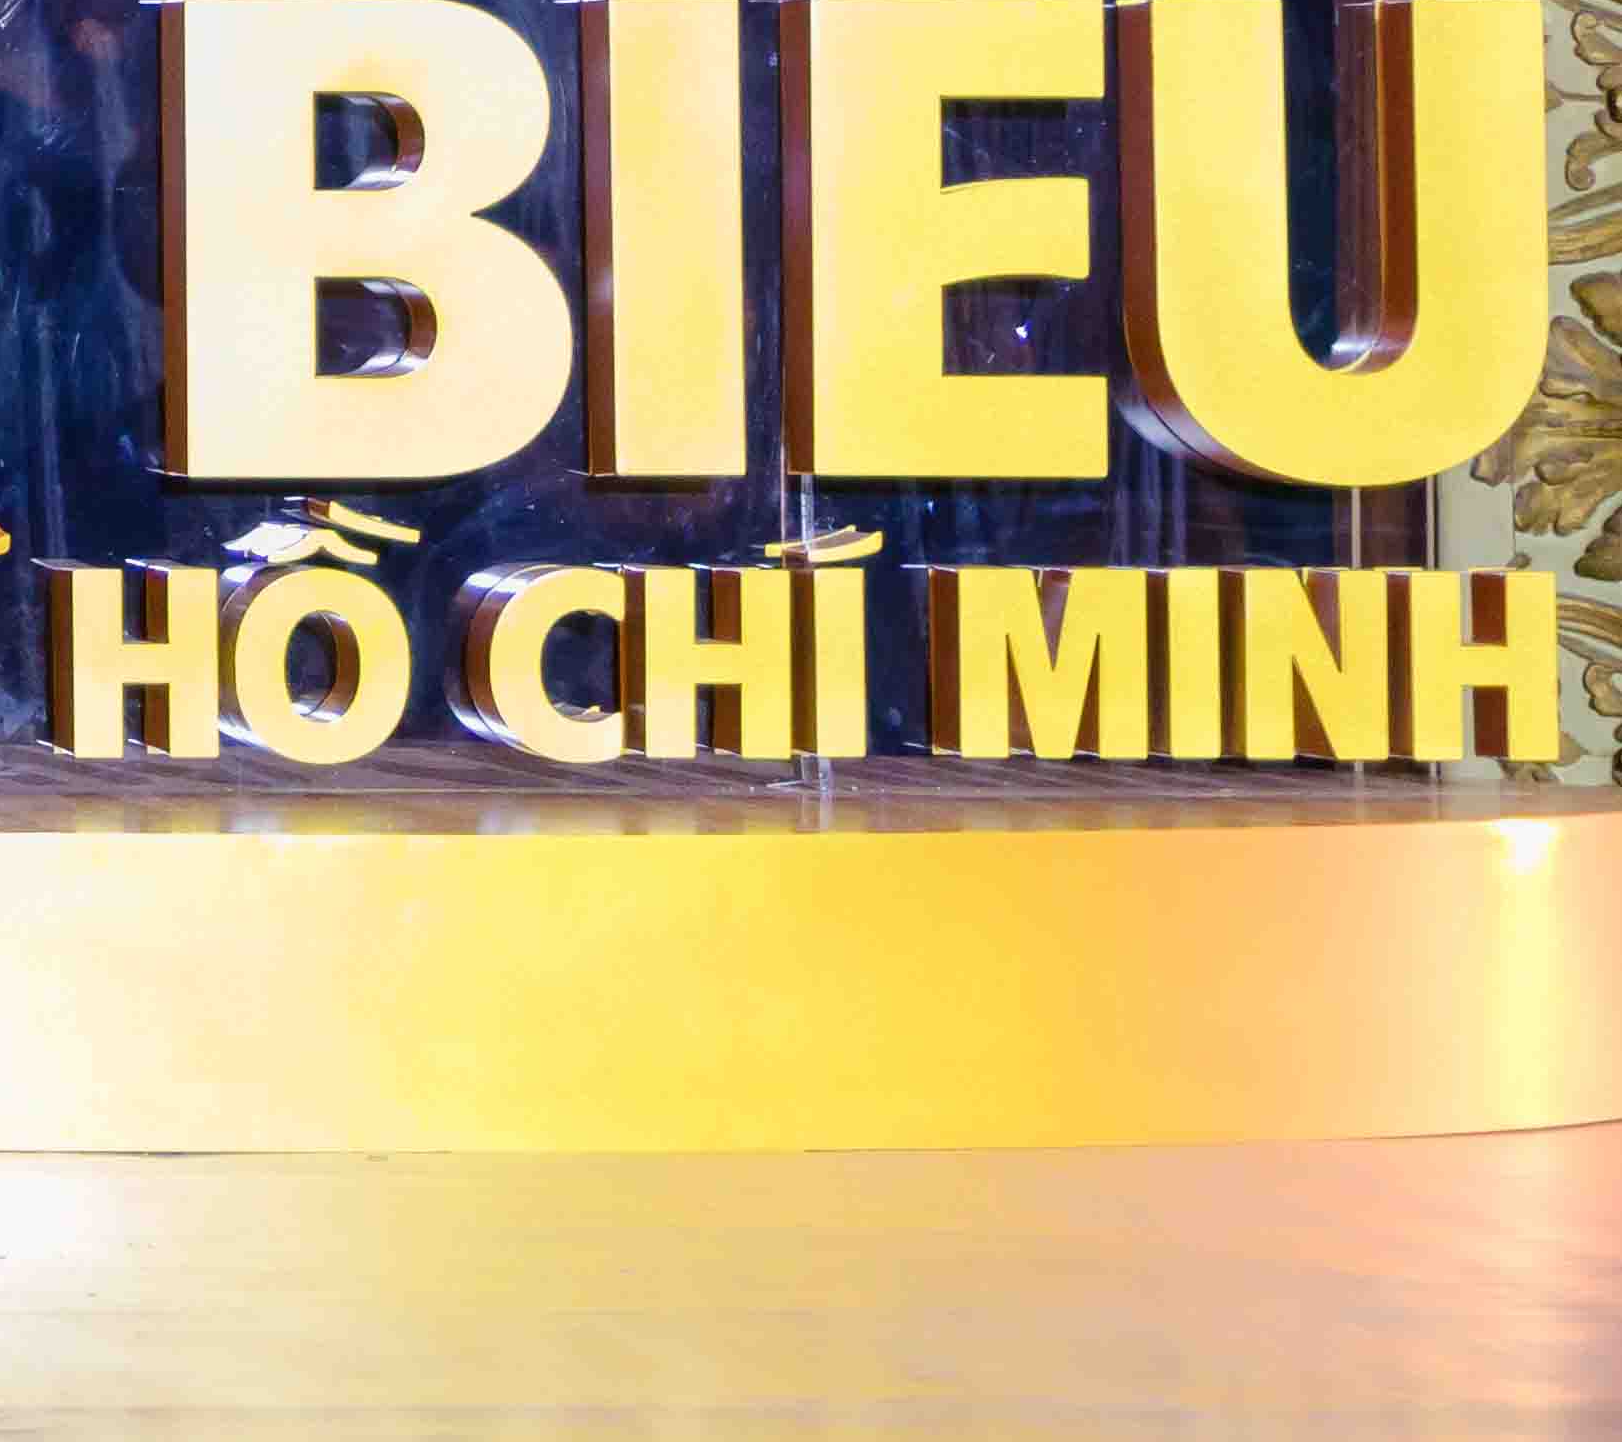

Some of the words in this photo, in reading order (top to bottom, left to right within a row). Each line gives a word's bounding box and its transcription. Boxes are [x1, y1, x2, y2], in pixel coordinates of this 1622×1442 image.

[57, 496, 421, 766] HỒ
[470, 524, 884, 763] CHÍ
[942, 565, 1559, 762] MINH
